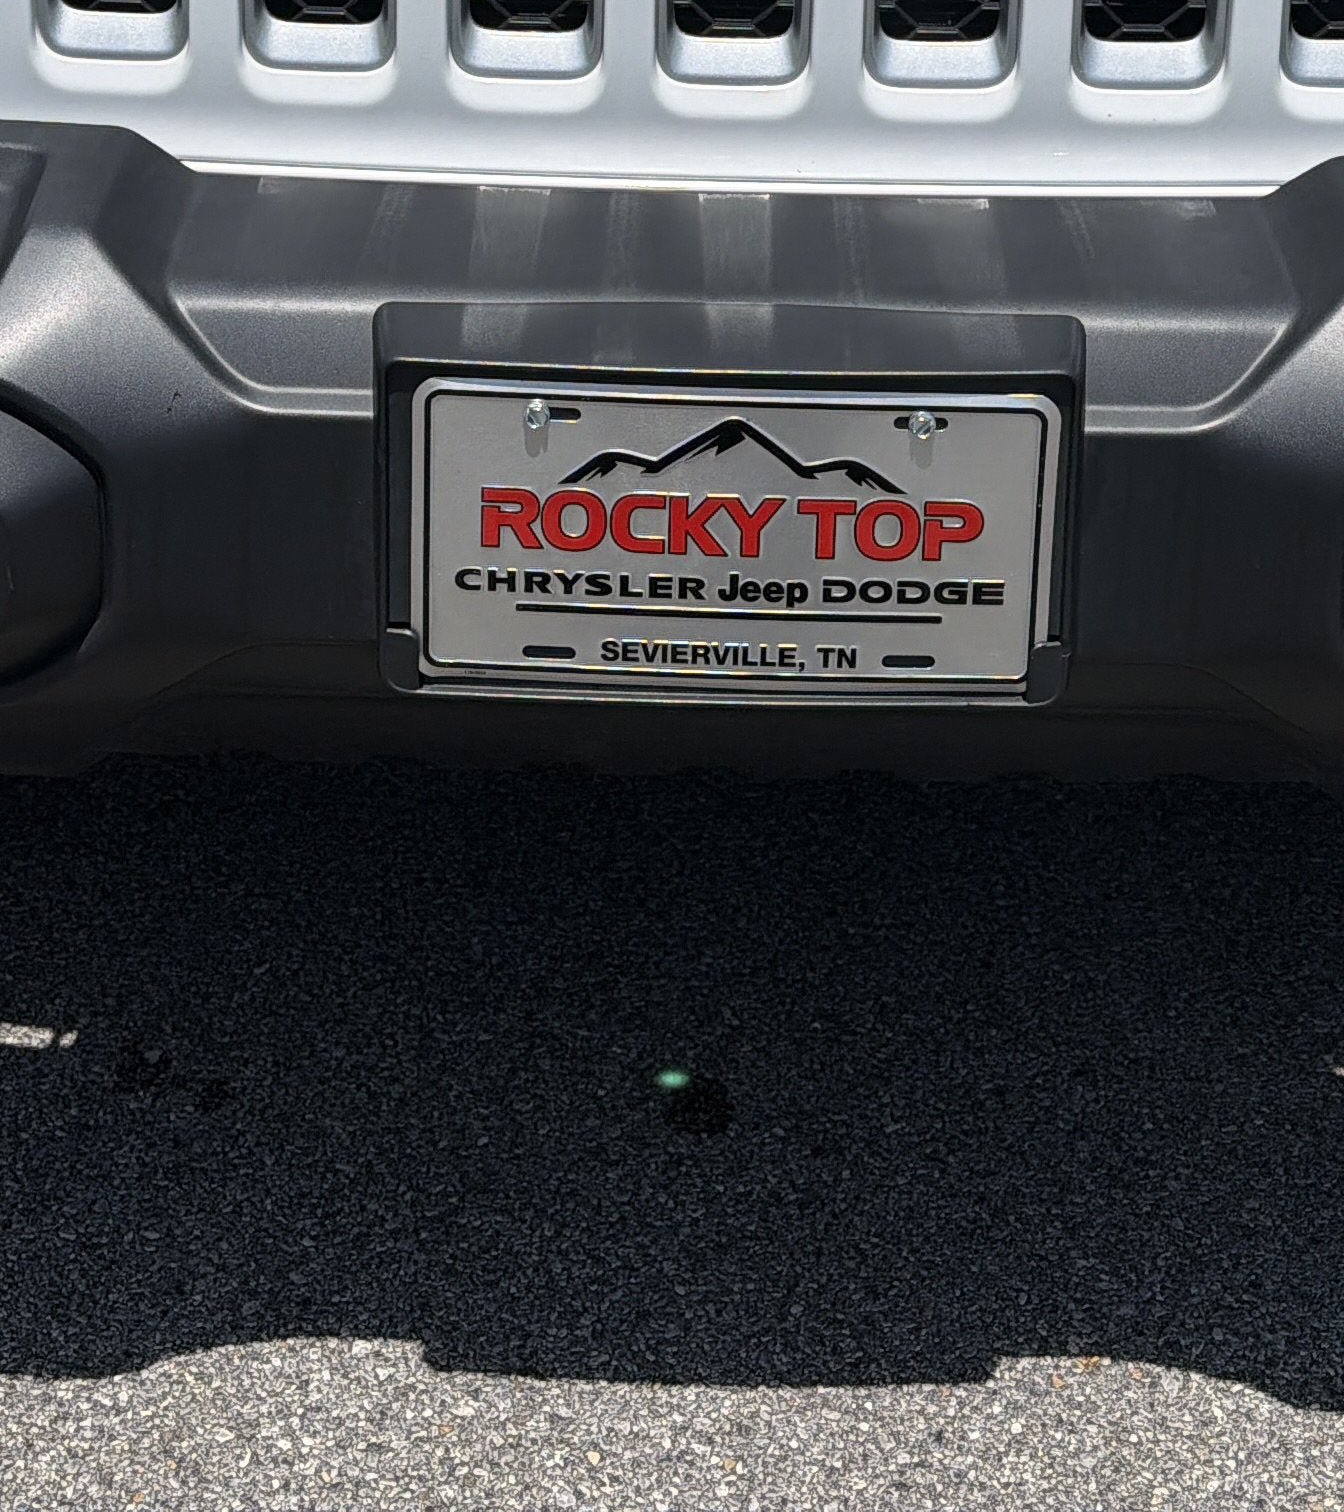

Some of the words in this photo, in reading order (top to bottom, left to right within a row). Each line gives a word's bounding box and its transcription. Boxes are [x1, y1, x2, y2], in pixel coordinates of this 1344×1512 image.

[481, 486, 787, 558] ROCKY
[797, 497, 984, 561] TOP
[454, 566, 706, 601] CHRYSLER
[718, 572, 809, 608] Jeep
[822, 577, 1005, 606] DODGE
[600, 639, 806, 672] SEVIERVILLE,
[816, 645, 857, 669] TN
